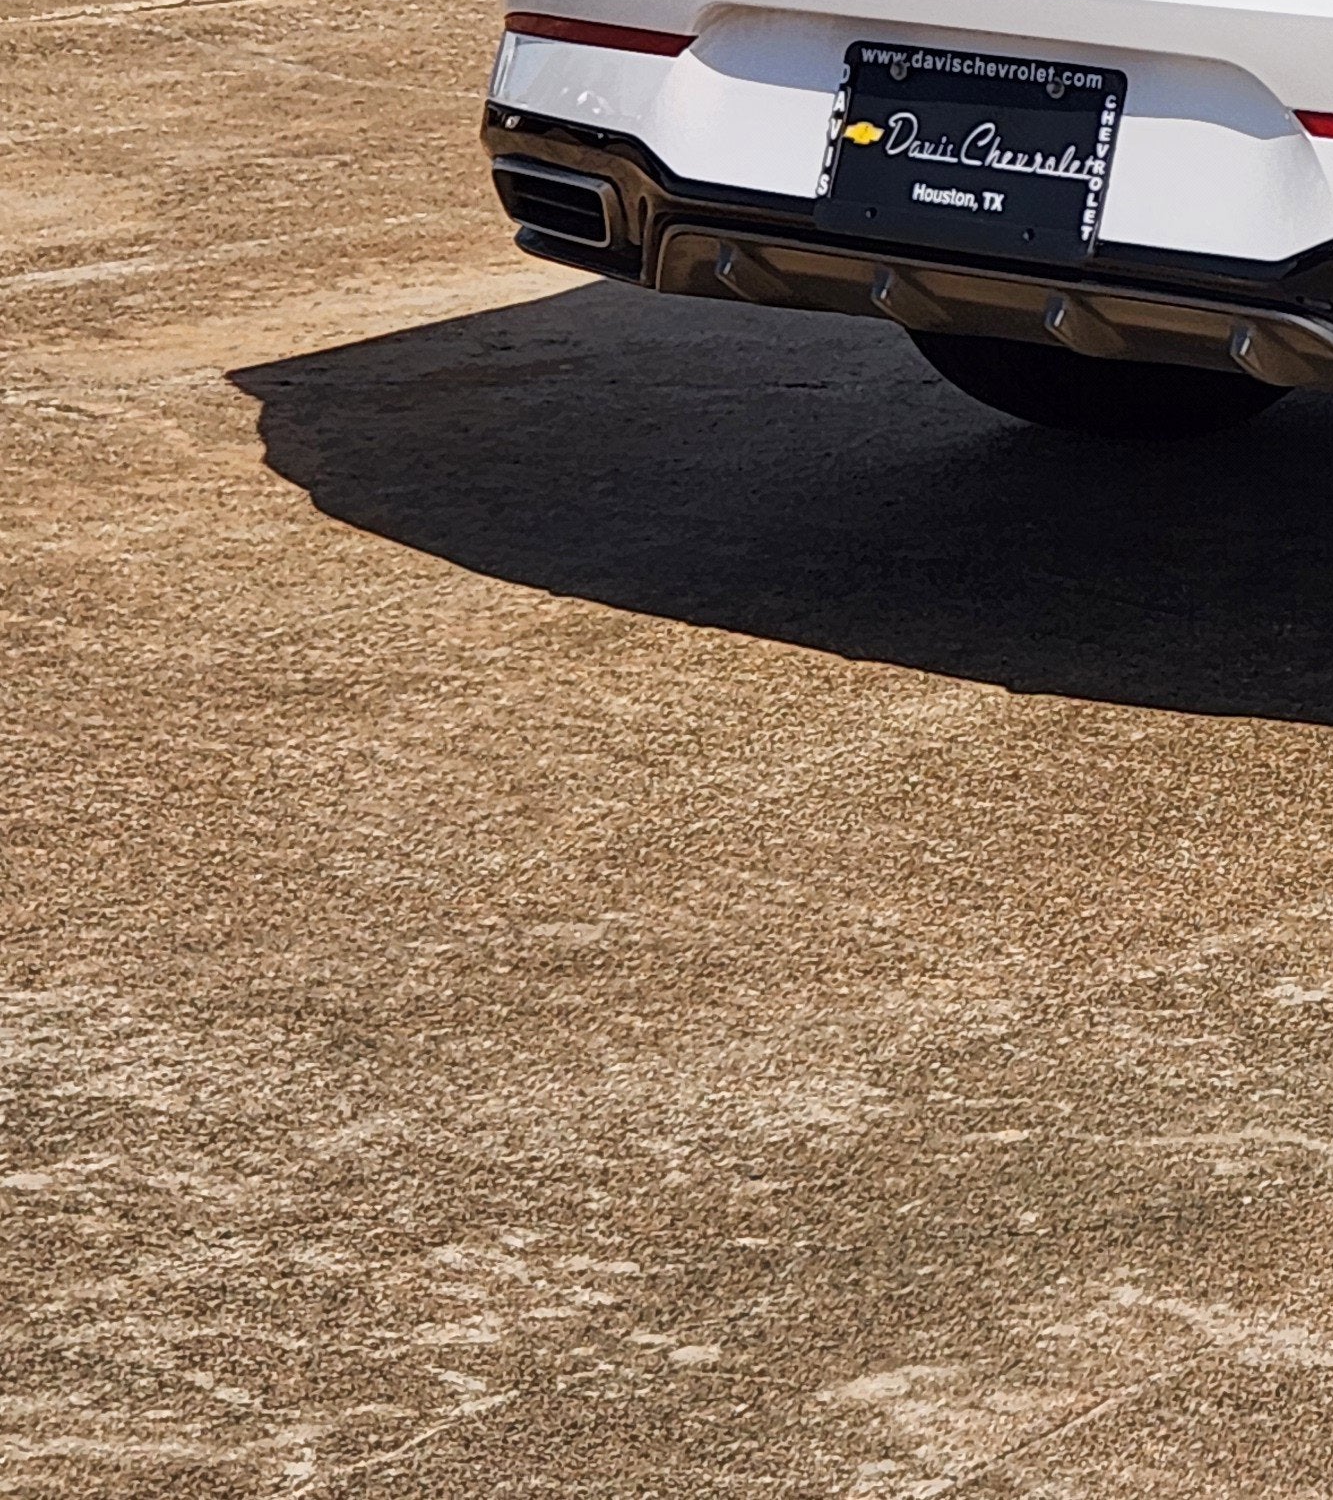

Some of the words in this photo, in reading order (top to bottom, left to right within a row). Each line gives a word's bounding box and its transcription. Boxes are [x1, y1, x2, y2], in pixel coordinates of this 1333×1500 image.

[860, 45, 1103, 91] www.davischevrolet.com
[885, 111, 959, 164] Davis
[960, 122, 1094, 181] Chevrolet
[912, 183, 979, 212] Houston,
[982, 190, 1005, 212] TX
